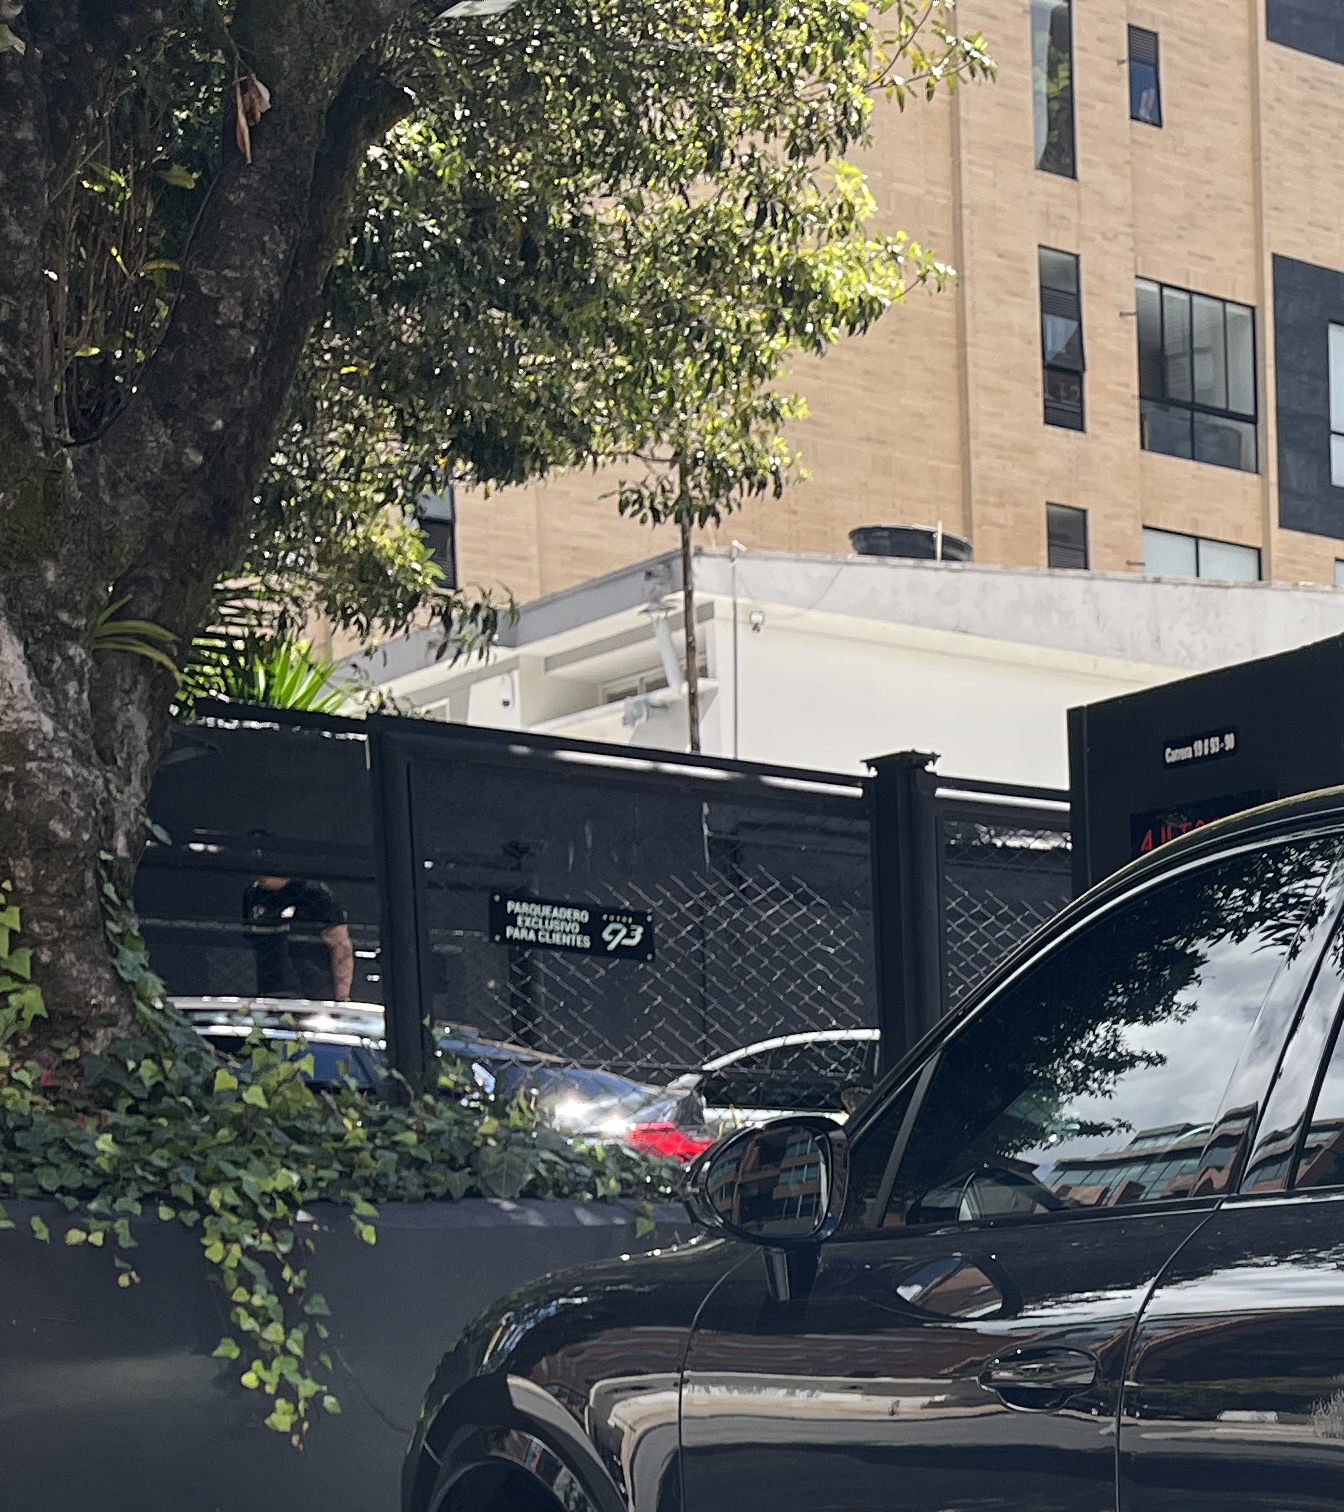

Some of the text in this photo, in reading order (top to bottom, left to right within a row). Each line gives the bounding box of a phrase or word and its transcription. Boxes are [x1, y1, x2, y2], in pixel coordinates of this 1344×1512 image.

[507, 900, 590, 924] PARQUEADERO
[516, 914, 580, 935] EXCLUSIVO
[506, 925, 591, 949] PARA CLIENTES
